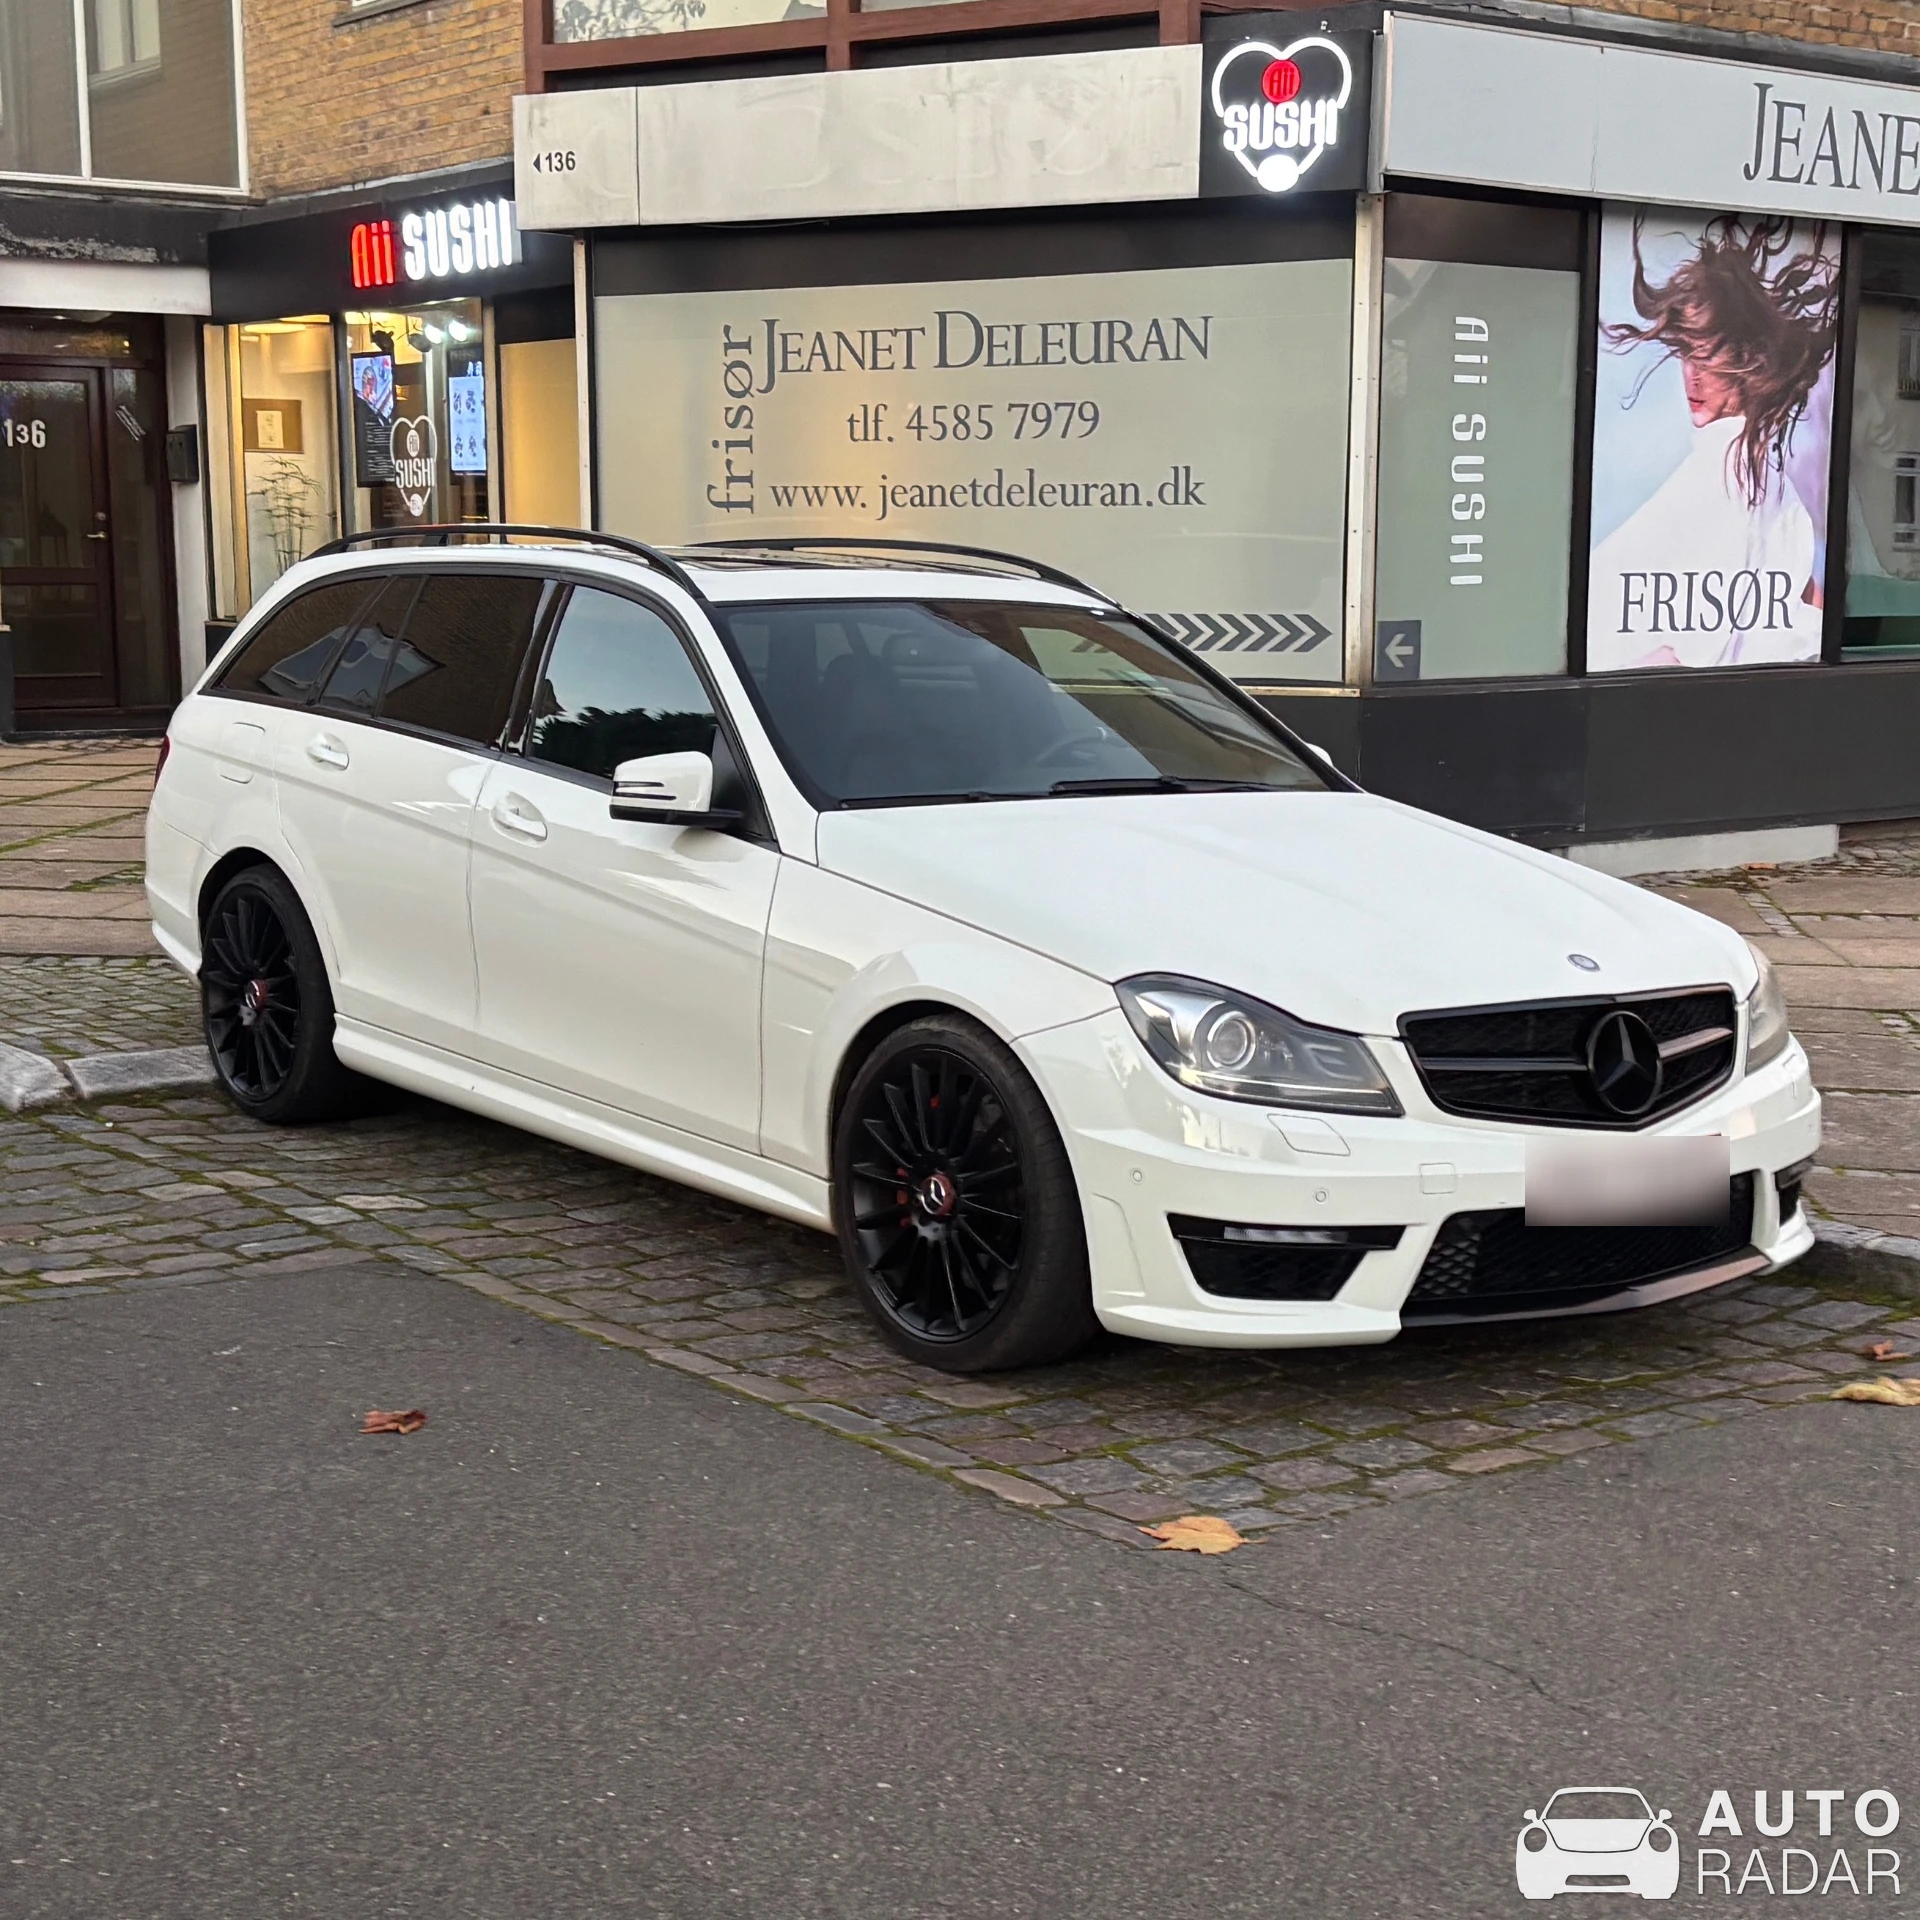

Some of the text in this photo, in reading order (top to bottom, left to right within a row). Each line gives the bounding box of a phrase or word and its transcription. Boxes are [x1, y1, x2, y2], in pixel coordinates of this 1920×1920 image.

[1269, 67, 1295, 96] Aii
[1223, 98, 1338, 152] SUSHI
[1743, 82, 1920, 196] JEANE
[545, 150, 576, 173] 136
[351, 197, 513, 289] Aii SUSHI
[756, 310, 1214, 394] JEANET DELEURAN
[3, 418, 46, 449] 136
[706, 324, 755, 514] frisør
[847, 400, 1101, 443] tlf. 4585 7979
[395, 457, 436, 489] SUSHI
[1449, 316, 1489, 586] Aii SUSHI
[1616, 568, 1793, 634] FRISØR
